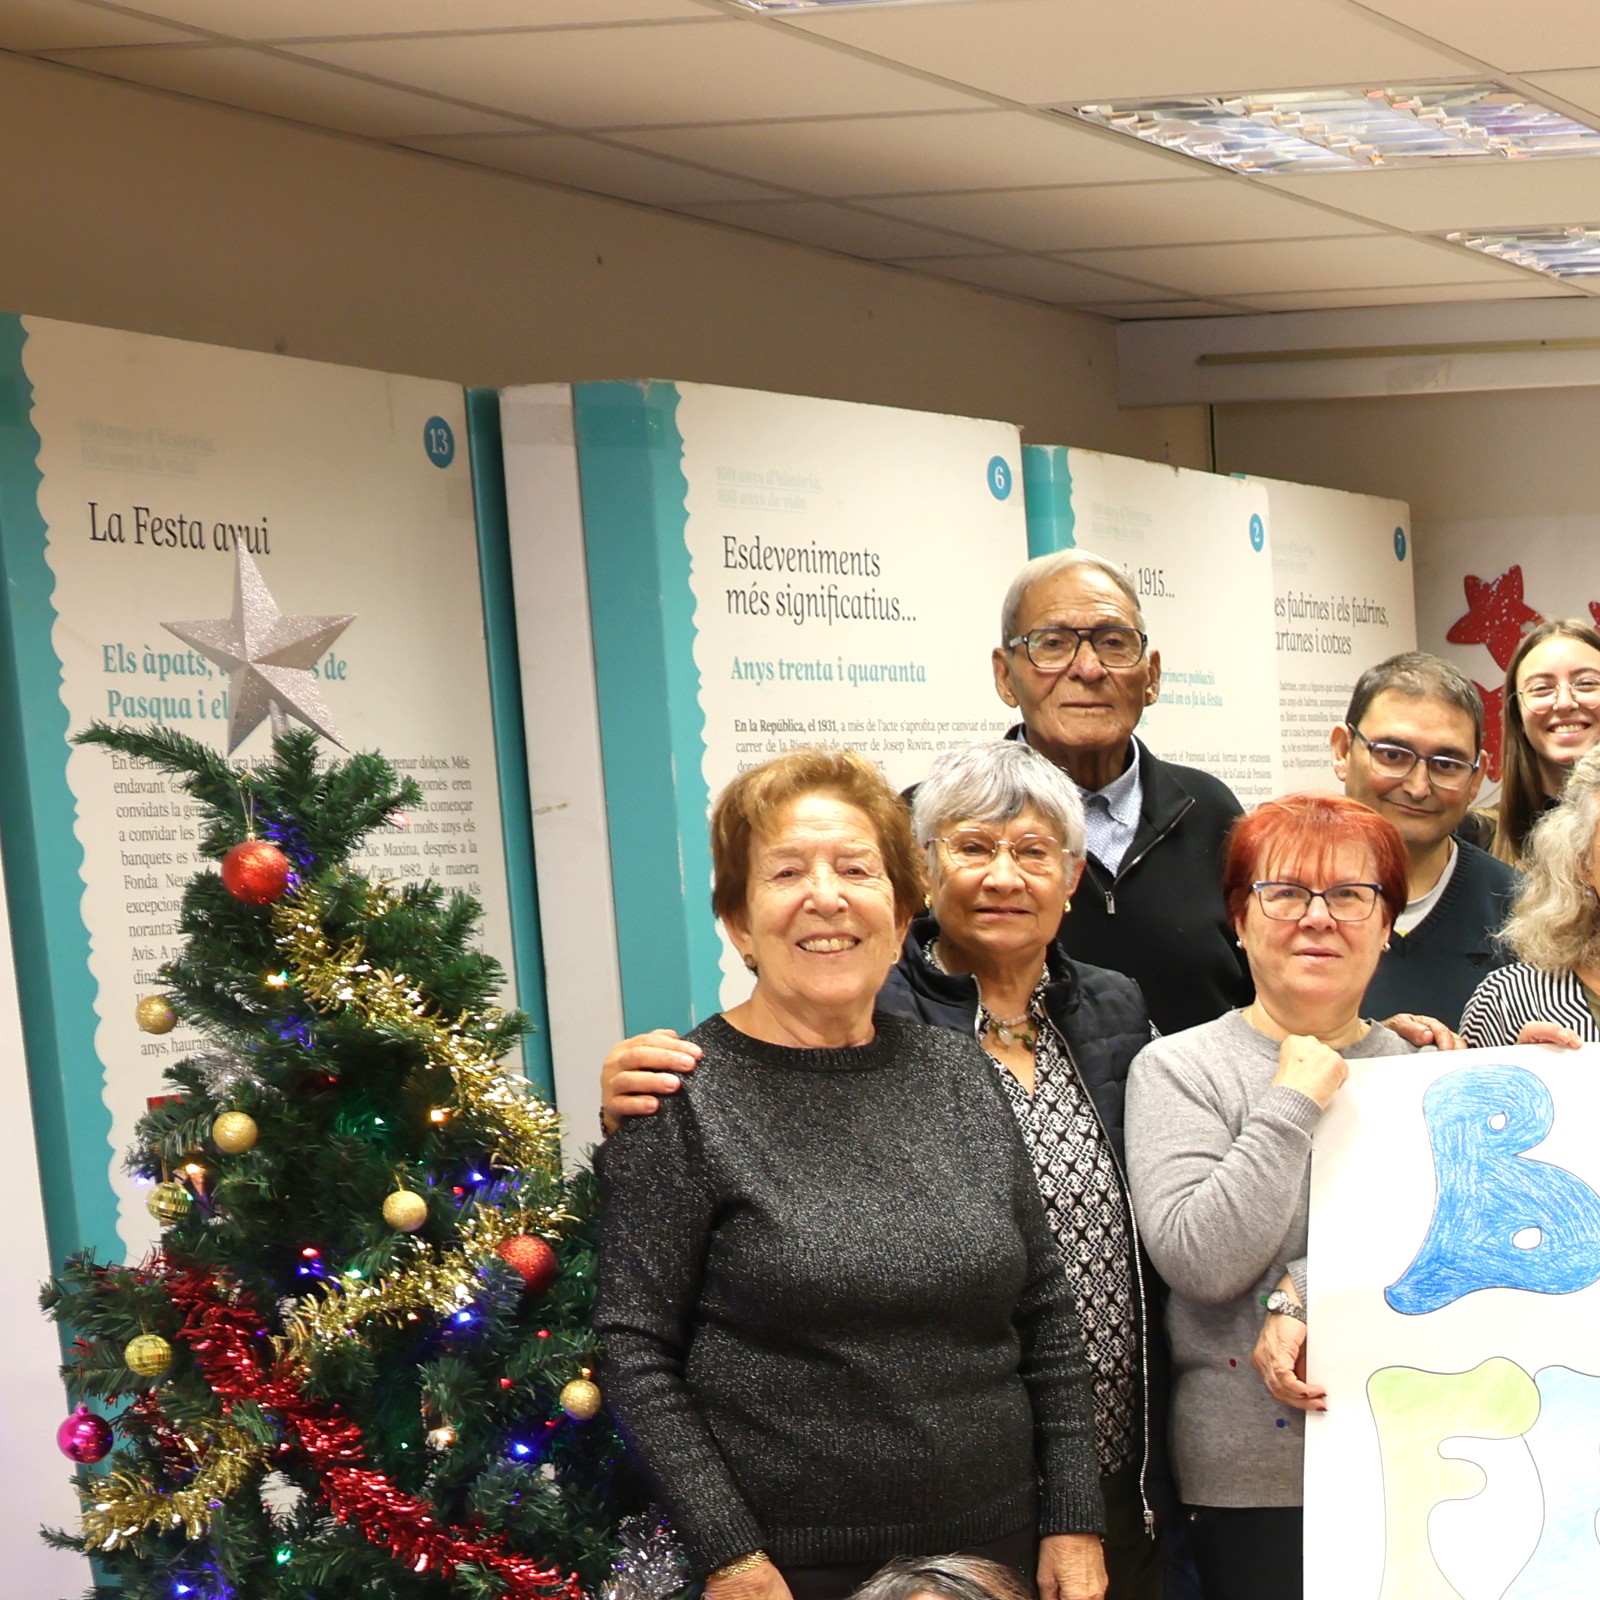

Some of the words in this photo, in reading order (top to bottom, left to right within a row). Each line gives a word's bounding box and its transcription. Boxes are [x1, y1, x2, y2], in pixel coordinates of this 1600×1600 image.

[430, 428, 449, 456] 13
[994, 465, 1005, 489] 6
[88, 502, 125, 544] La
[133, 506, 205, 549] Festa
[1253, 522, 1260, 542] 2
[722, 535, 881, 577] Esdeveniments
[726, 582, 770, 616] més
[775, 583, 917, 626] significatius...
[1275, 597, 1285, 617] es
[1287, 591, 1329, 623] fadrines
[1337, 597, 1350, 622] els
[1352, 597, 1389, 628] fadrins,
[1321, 634, 1352, 654] cotxes
[102, 644, 137, 674] Els
[143, 645, 213, 682] àpats,
[324, 653, 347, 681] de
[731, 656, 774, 686] Anys
[779, 659, 833, 682] trenta
[837, 657, 844, 681] i
[847, 661, 926, 687] quaranta
[107, 690, 192, 726] Pasqua
[197, 689, 205, 720] i
[211, 691, 229, 720] el
[734, 719, 747, 732] En
[749, 719, 758, 732] la
[760, 718, 806, 735] República,
[808, 718, 816, 732] el
[848, 719, 865, 732] més
[866, 719, 877, 732] de
[937, 722, 950, 735] per
[951, 719, 978, 732] canviar
[980, 719, 988, 732] el
[736, 740, 762, 753] carrer
[765, 739, 776, 752] de
[778, 739, 787, 752] la
[870, 739, 881, 752] de
[882, 738, 905, 754] Josep
[907, 738, 935, 753] Rovira,
[936, 741, 947, 751] en
[111, 754, 126, 770] En
[387, 756, 418, 770] erenar
[114, 779, 164, 794] endavant
[452, 781, 472, 791] eren
[116, 802, 169, 818] convidats
[171, 802, 181, 817] la
[119, 830, 126, 841] a
[129, 826, 177, 841] convidar
[180, 825, 195, 840] les
[464, 818, 476, 832] els
[121, 850, 172, 868] banquets
[176, 853, 188, 863] es
[429, 862, 440, 876] de
[124, 874, 158, 890] Fonda
[126, 899, 182, 915] excepcion
[129, 922, 172, 938] noranta
[132, 945, 158, 961] Avis.
[160, 944, 171, 960] A
[141, 1040, 170, 1058] anys,
